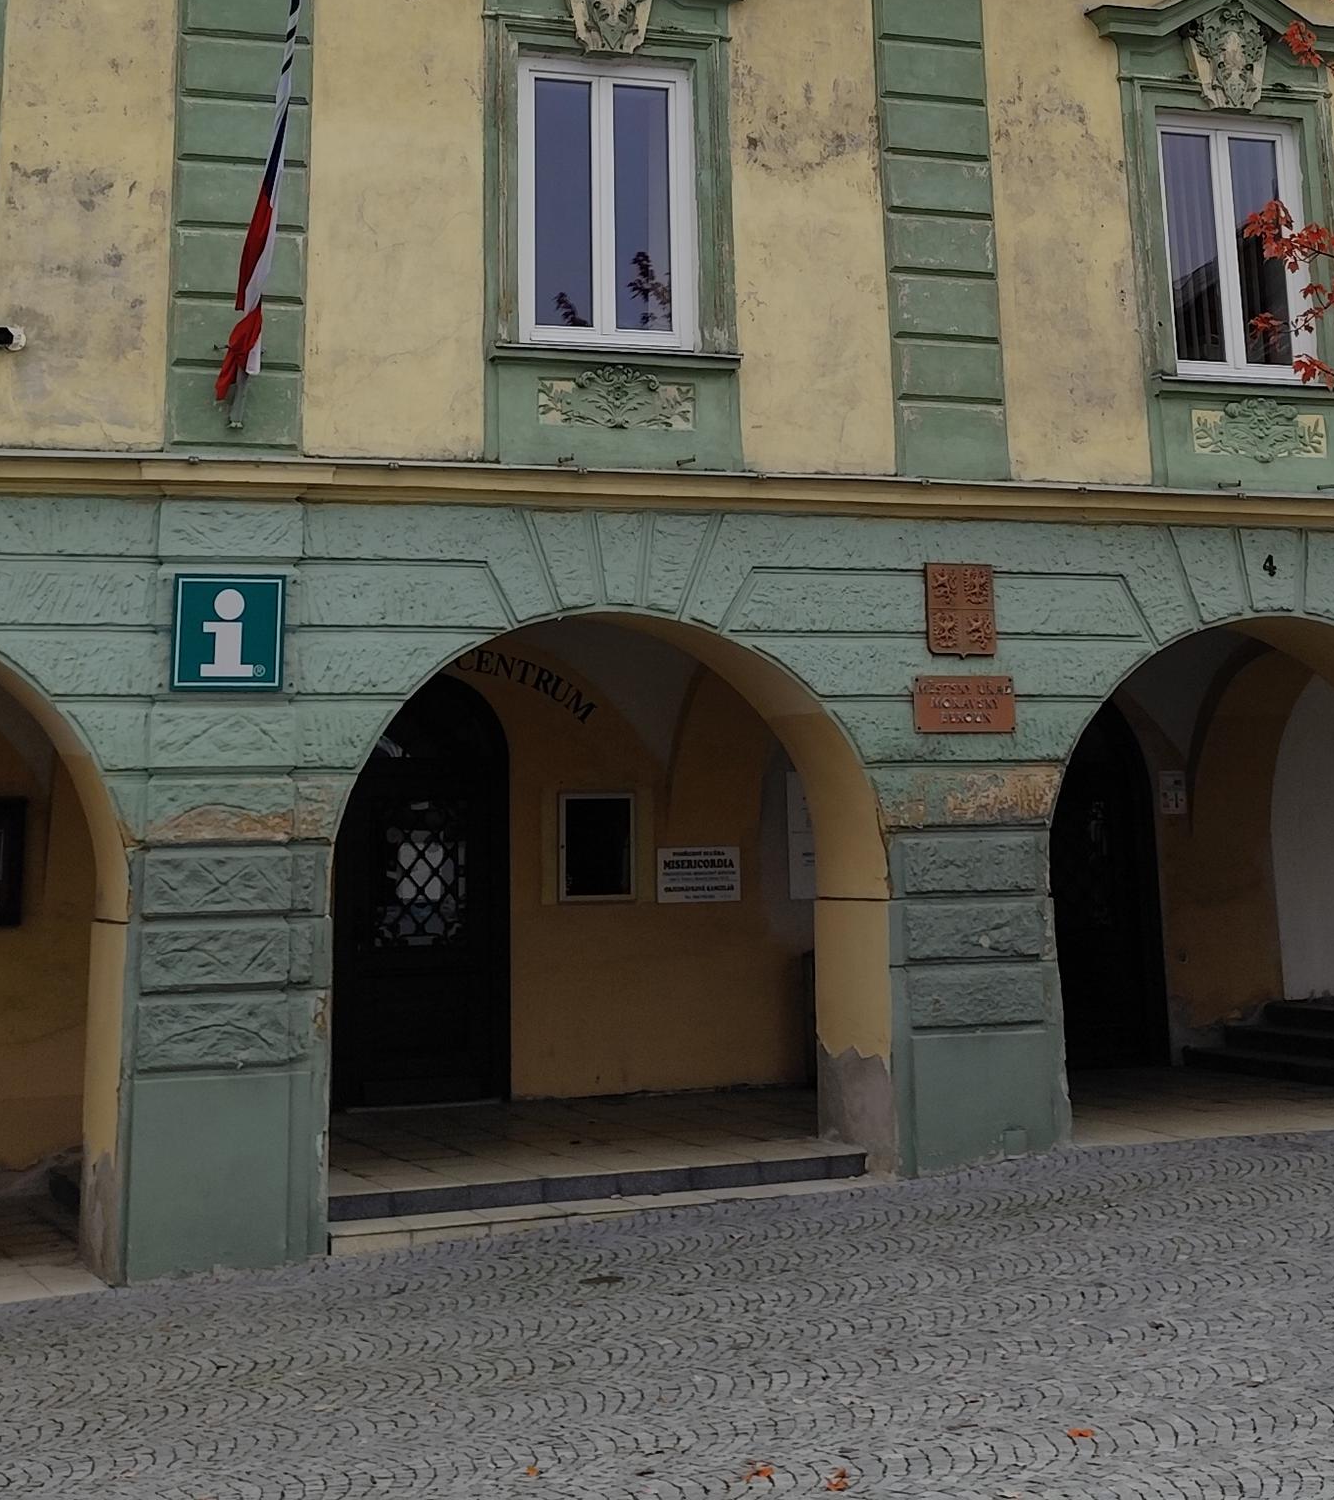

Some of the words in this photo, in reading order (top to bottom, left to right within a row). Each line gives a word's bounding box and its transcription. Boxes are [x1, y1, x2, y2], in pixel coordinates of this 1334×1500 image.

[1263, 554, 1277, 577] 4
[453, 649, 598, 725] CENTRUM
[939, 711, 993, 725] BEROUN
[663, 858, 735, 870] MISERICORDIA
